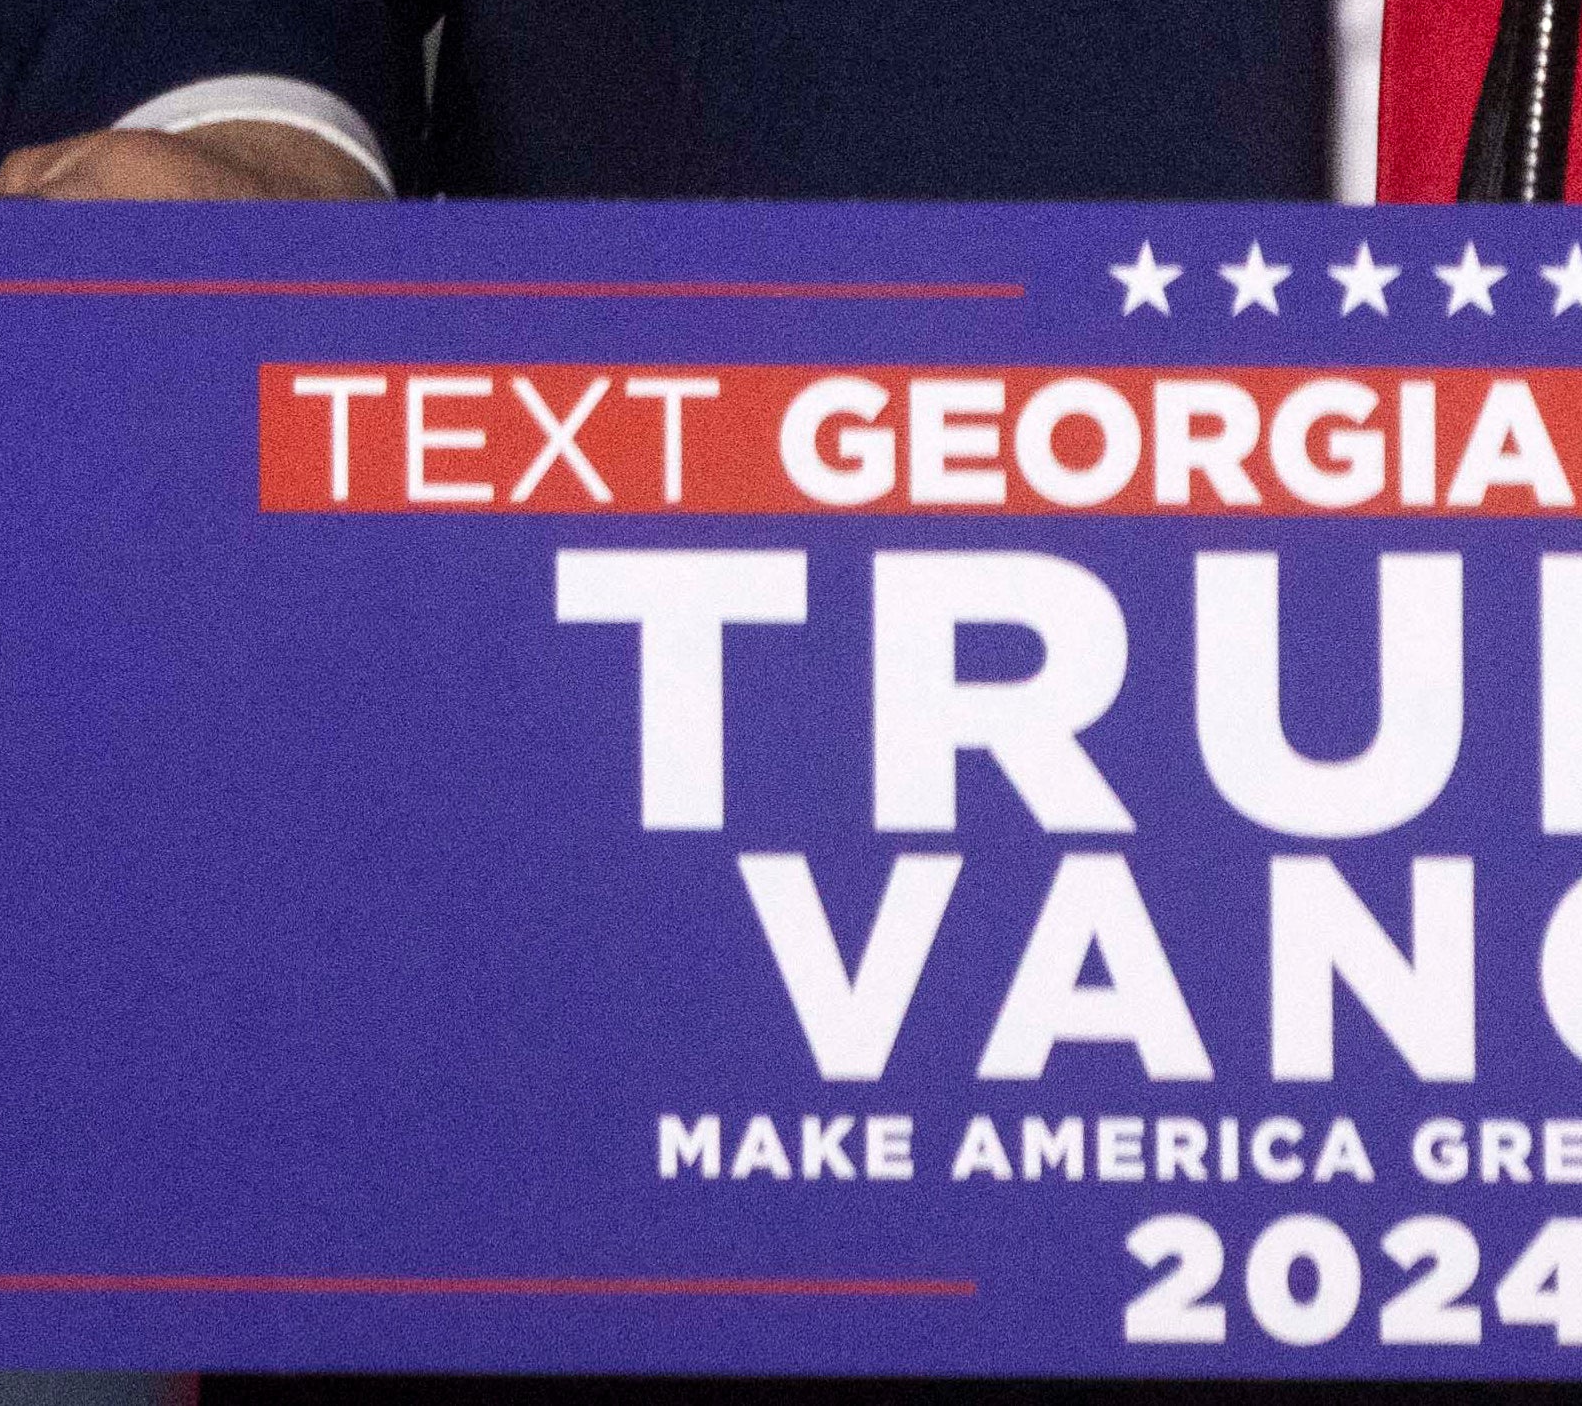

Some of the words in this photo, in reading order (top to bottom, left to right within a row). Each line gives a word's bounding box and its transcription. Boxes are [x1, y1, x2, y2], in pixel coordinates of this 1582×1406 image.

[291, 374, 722, 505] TEXT
[777, 374, 1577, 510] GEORGIA
[657, 1114, 915, 1181] MAKE
[951, 1115, 1376, 1183] AMERICA
